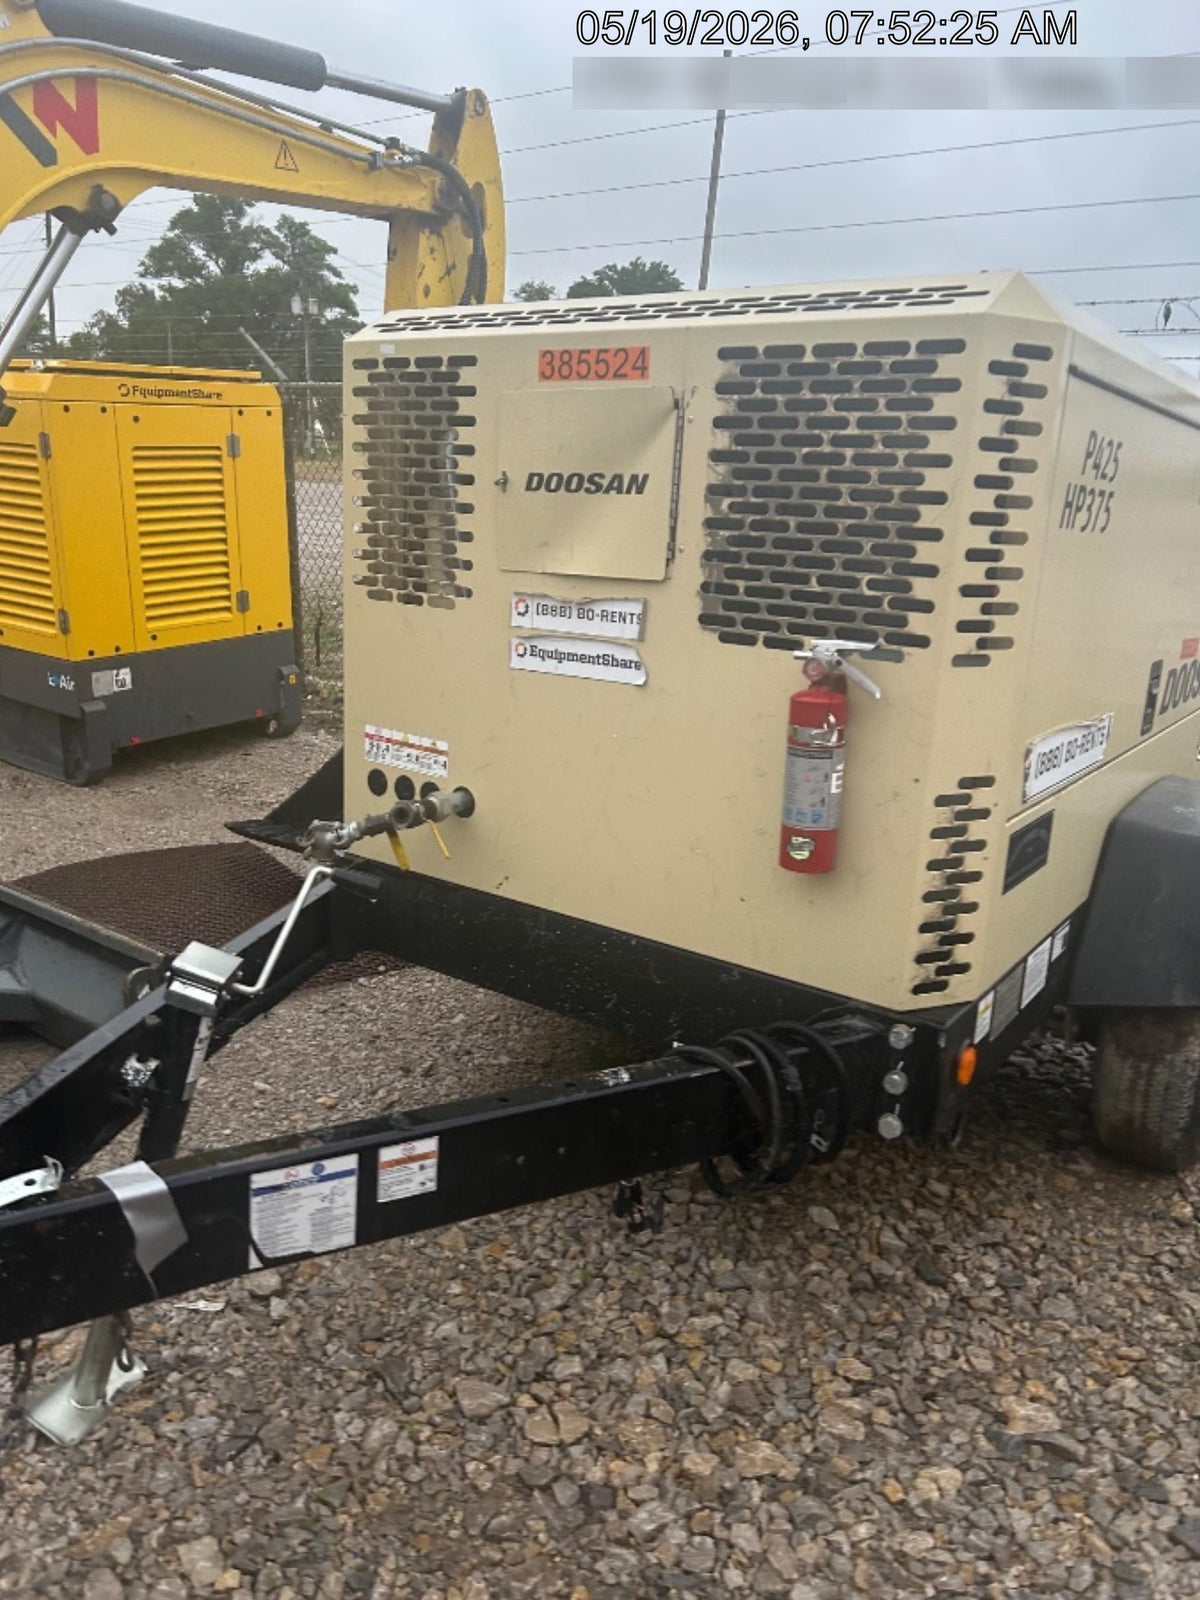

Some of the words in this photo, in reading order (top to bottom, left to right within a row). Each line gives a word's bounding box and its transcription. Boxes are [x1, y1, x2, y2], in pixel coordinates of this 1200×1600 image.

[540, 347, 648, 379] 385524
[1081, 430, 1123, 482] P425
[524, 472, 650, 495] DOOSAN
[1059, 483, 1115, 534] HP375
[529, 644, 641, 671] EquipmentShare
